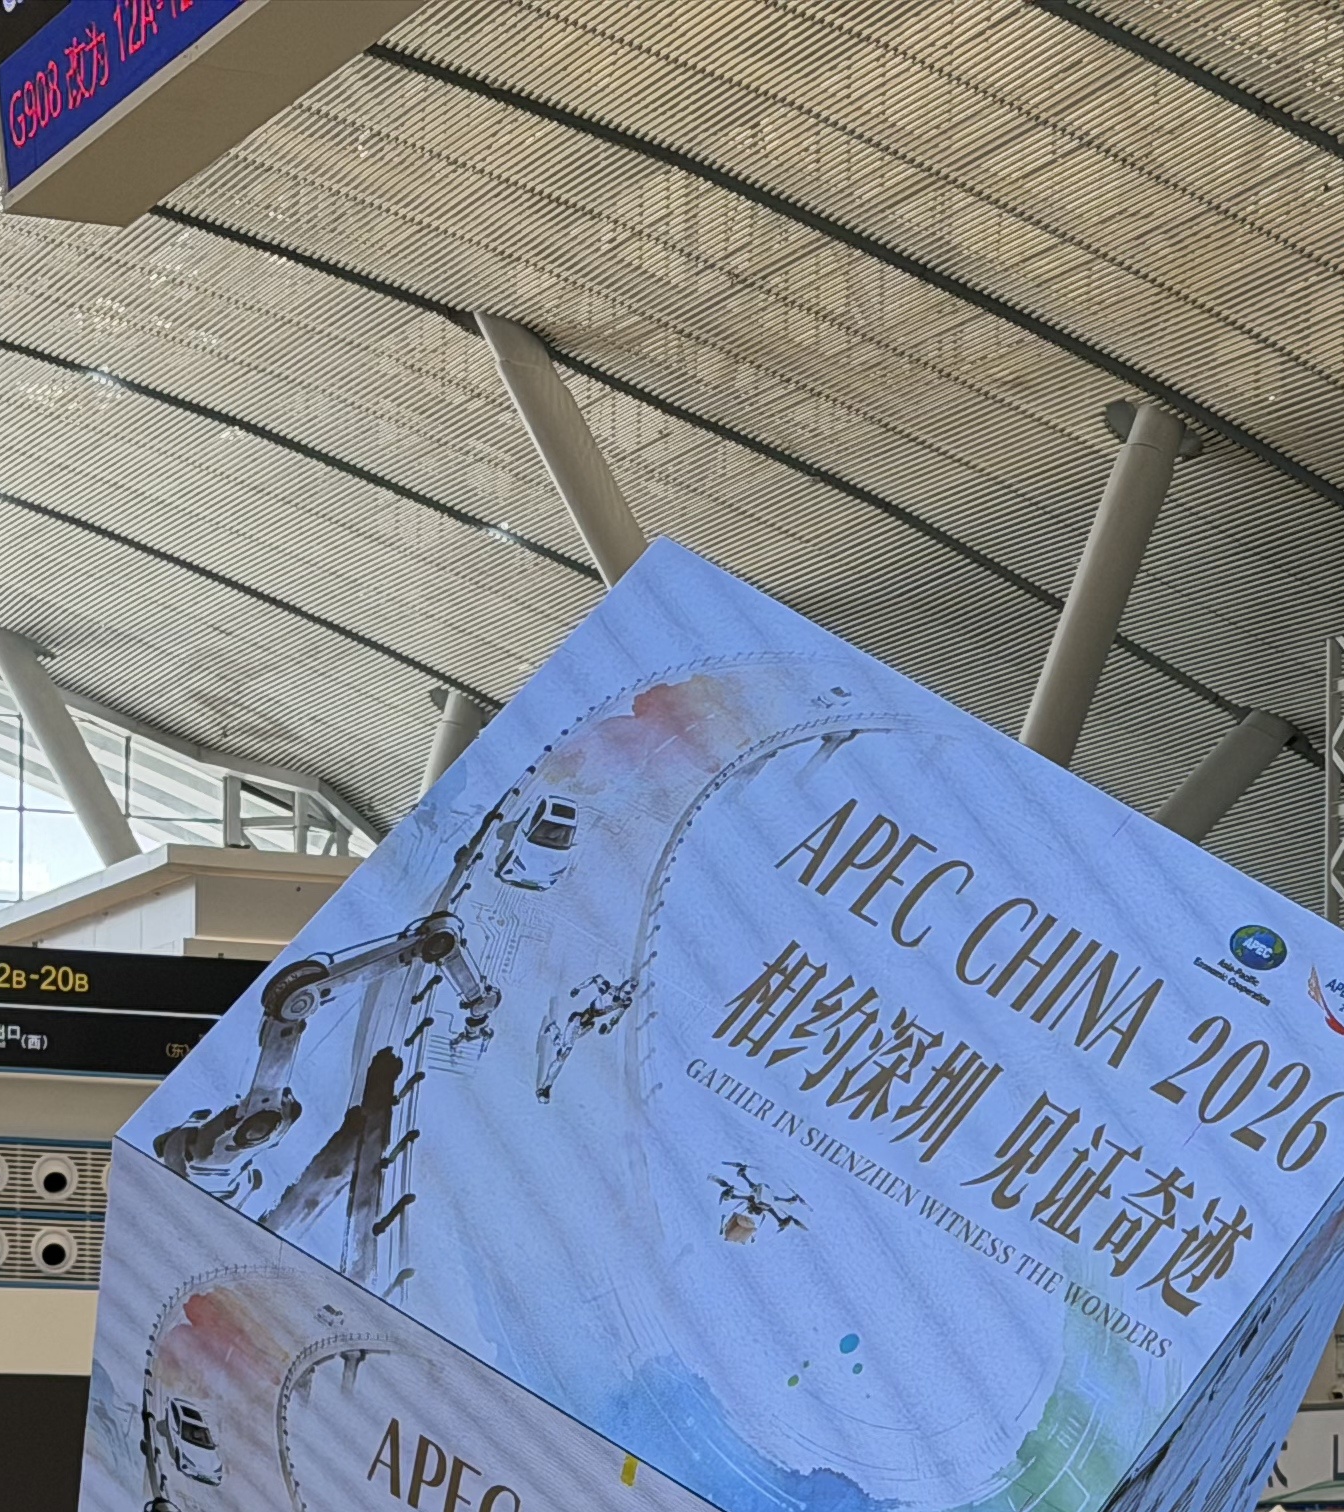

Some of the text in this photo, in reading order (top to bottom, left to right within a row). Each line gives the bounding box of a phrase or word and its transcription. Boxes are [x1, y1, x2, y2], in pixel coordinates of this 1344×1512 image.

[9, 60, 63, 147] G908
[775, 797, 975, 949] APEC
[955, 896, 1166, 1070] CHINA
[1242, 938, 1274, 960] APEC
[686, 1058, 1174, 1359] GATHER IN SHENZHEN WITNESS THE WONDERS
[712, 939, 1256, 1318] 相约深圳 见证奇迹
